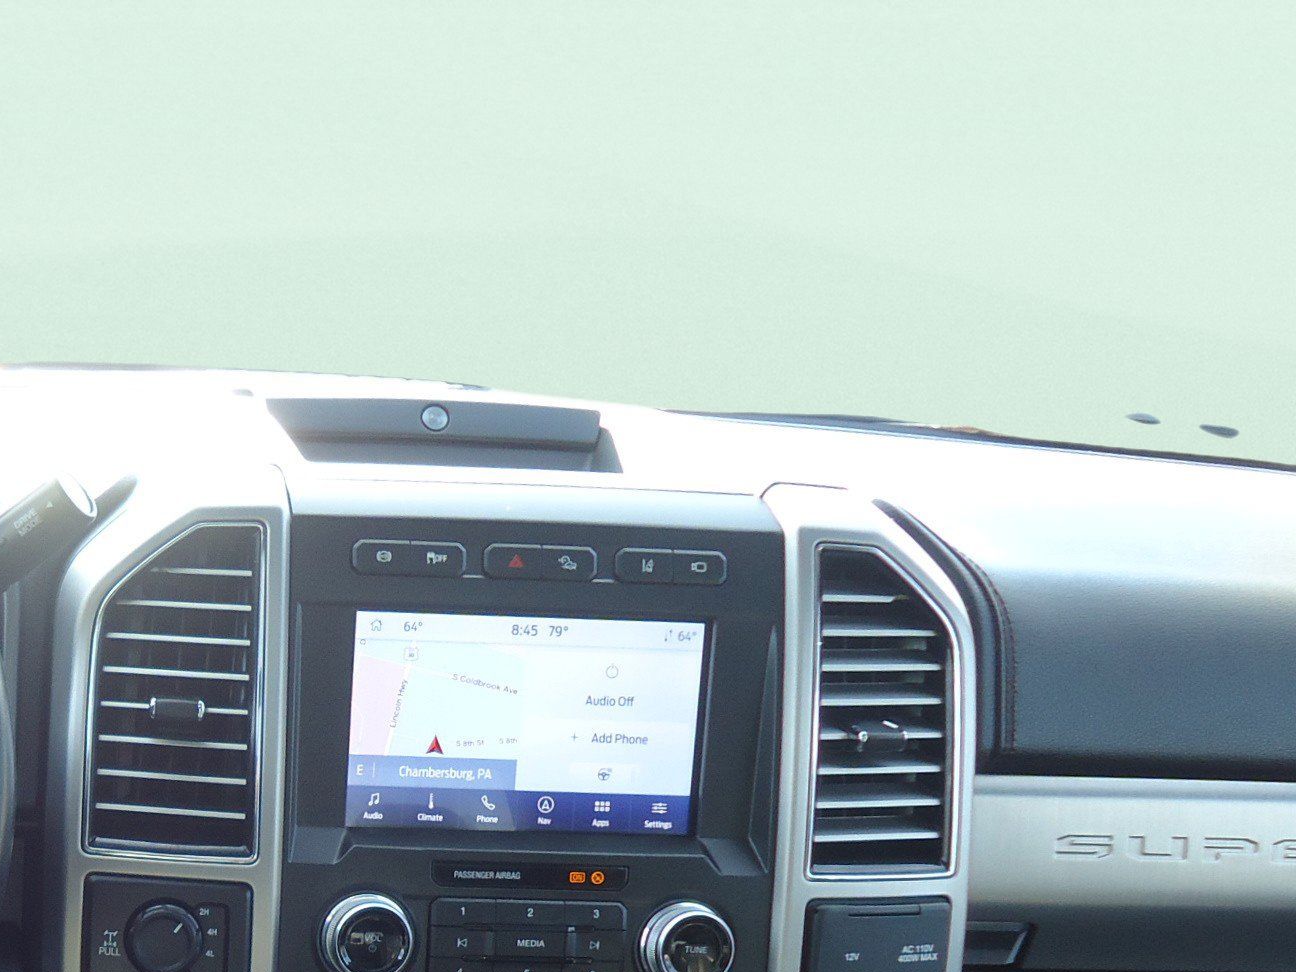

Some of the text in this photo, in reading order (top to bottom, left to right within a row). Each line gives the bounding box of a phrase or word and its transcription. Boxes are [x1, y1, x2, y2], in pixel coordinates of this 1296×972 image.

[511, 624, 538, 636] 8:45
[549, 625, 569, 637] 79°
[460, 675, 501, 691] Coldbrook
[503, 685, 518, 695] Ave
[586, 695, 634, 707] Audio Off
[390, 699, 402, 728] Lincoln
[591, 733, 648, 745] Add Phone
[356, 764, 364, 776] E
[399, 765, 493, 781] Chambersburg, PA
[363, 811, 383, 820] Audio
[417, 813, 443, 823] Climate
[476, 815, 499, 824] Phone
[537, 817, 552, 826] Nav
[591, 818, 610, 828] Apps
[644, 820, 673, 830] Settings
[454, 870, 521, 880] PASSENGER AIRBAG
[460, 906, 466, 915] 1
[527, 908, 534, 918] 2
[593, 909, 600, 918] 3
[207, 928, 218, 936] 4H
[517, 939, 545, 948] MEDIA
[98, 946, 121, 956] PULL
